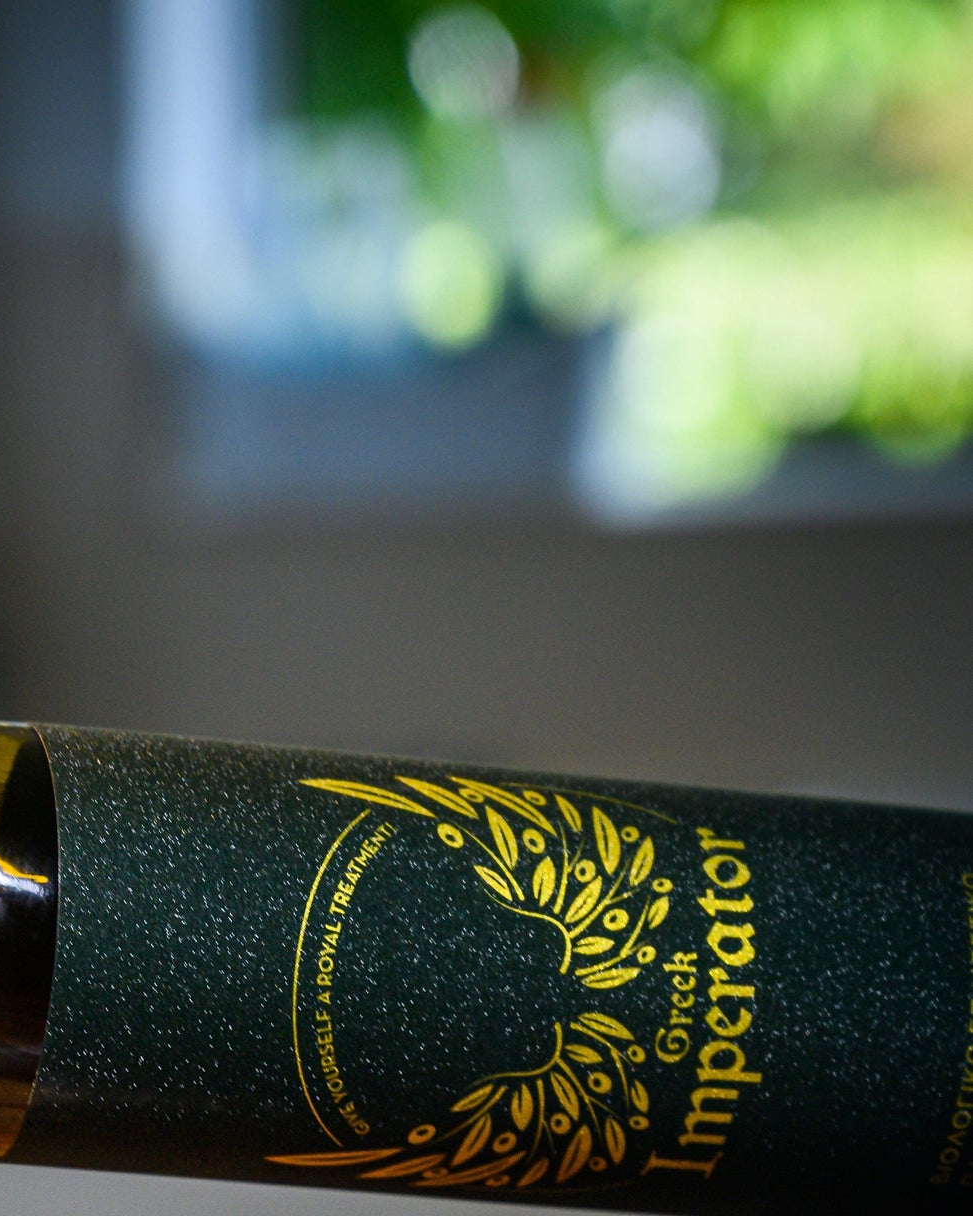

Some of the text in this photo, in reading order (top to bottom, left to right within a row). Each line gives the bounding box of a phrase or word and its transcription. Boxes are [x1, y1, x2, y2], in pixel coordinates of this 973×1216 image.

[316, 921, 342, 986] ROYAL
[316, 991, 331, 1005] A
[643, 826, 762, 1179] Imperator
[655, 951, 698, 1064] Greek
[316, 1010, 347, 1104] YOURSELF
[338, 1101, 370, 1136] GIVE
